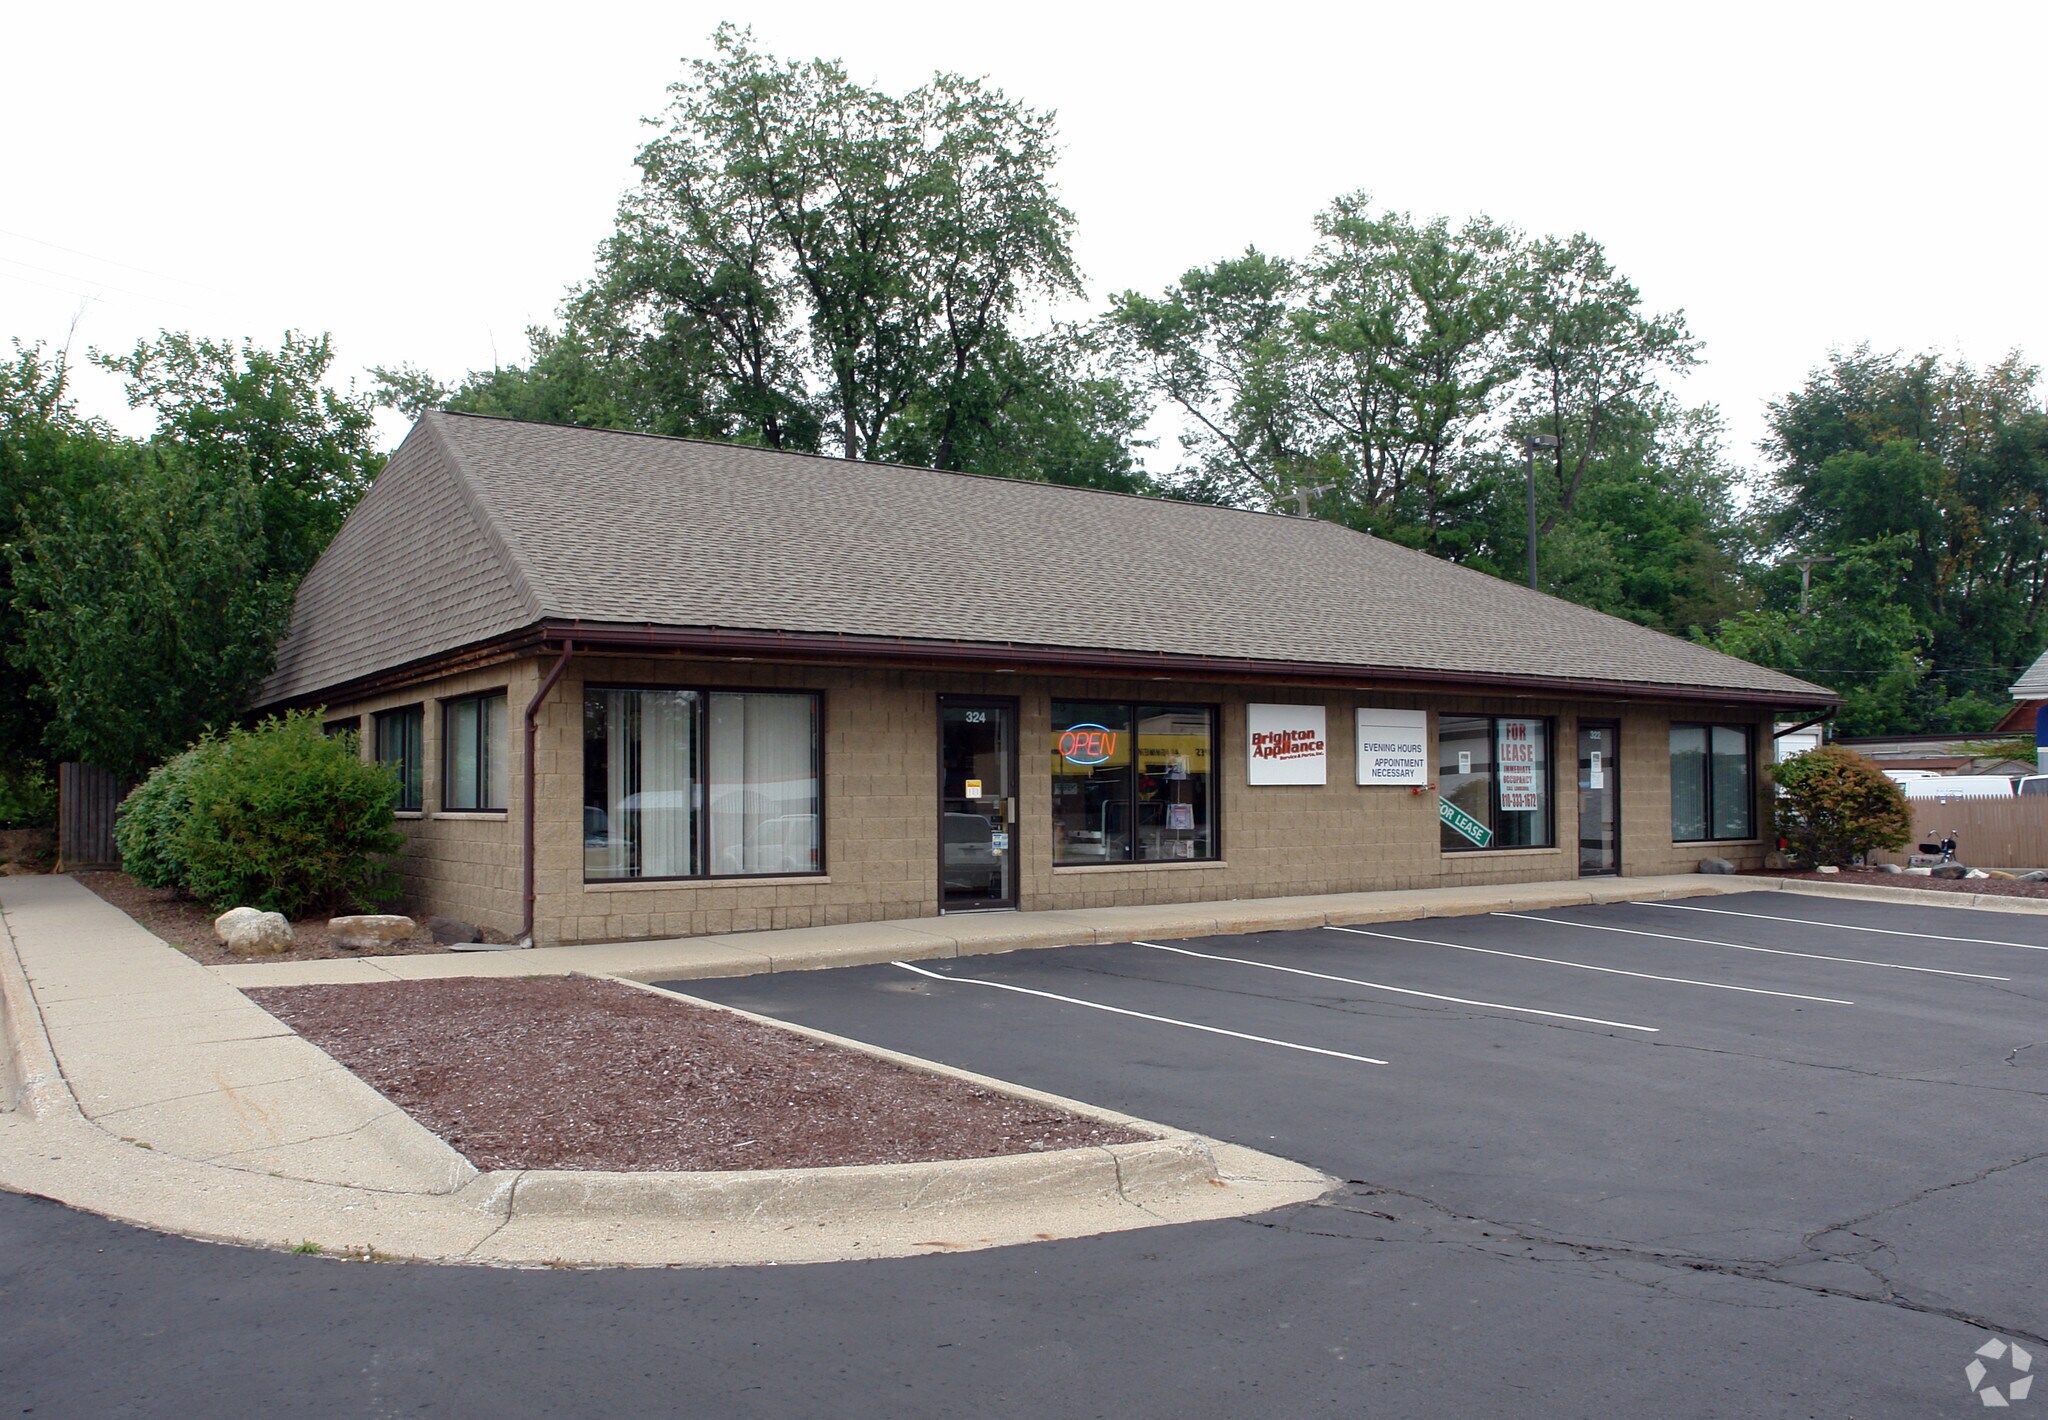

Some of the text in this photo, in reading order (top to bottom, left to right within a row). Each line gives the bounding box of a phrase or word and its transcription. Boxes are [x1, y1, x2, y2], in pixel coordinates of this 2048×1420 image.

[965, 711, 986, 723] 324
[1252, 729, 1315, 747] Brighton
[1505, 723, 1526, 741] FOR
[1058, 731, 1117, 756] OPEN
[1252, 740, 1324, 759] Appliance
[1363, 742, 1422, 753] EVENING HOURS
[1501, 743, 1533, 762] LEASE
[1374, 758, 1424, 768] APPOINTMENT
[1503, 765, 1531, 774] IMMEDIATE
[1371, 768, 1415, 778] NECESSARY
[1503, 775, 1532, 784] OCCUPANCY
[1455, 815, 1484, 840] LEASE
